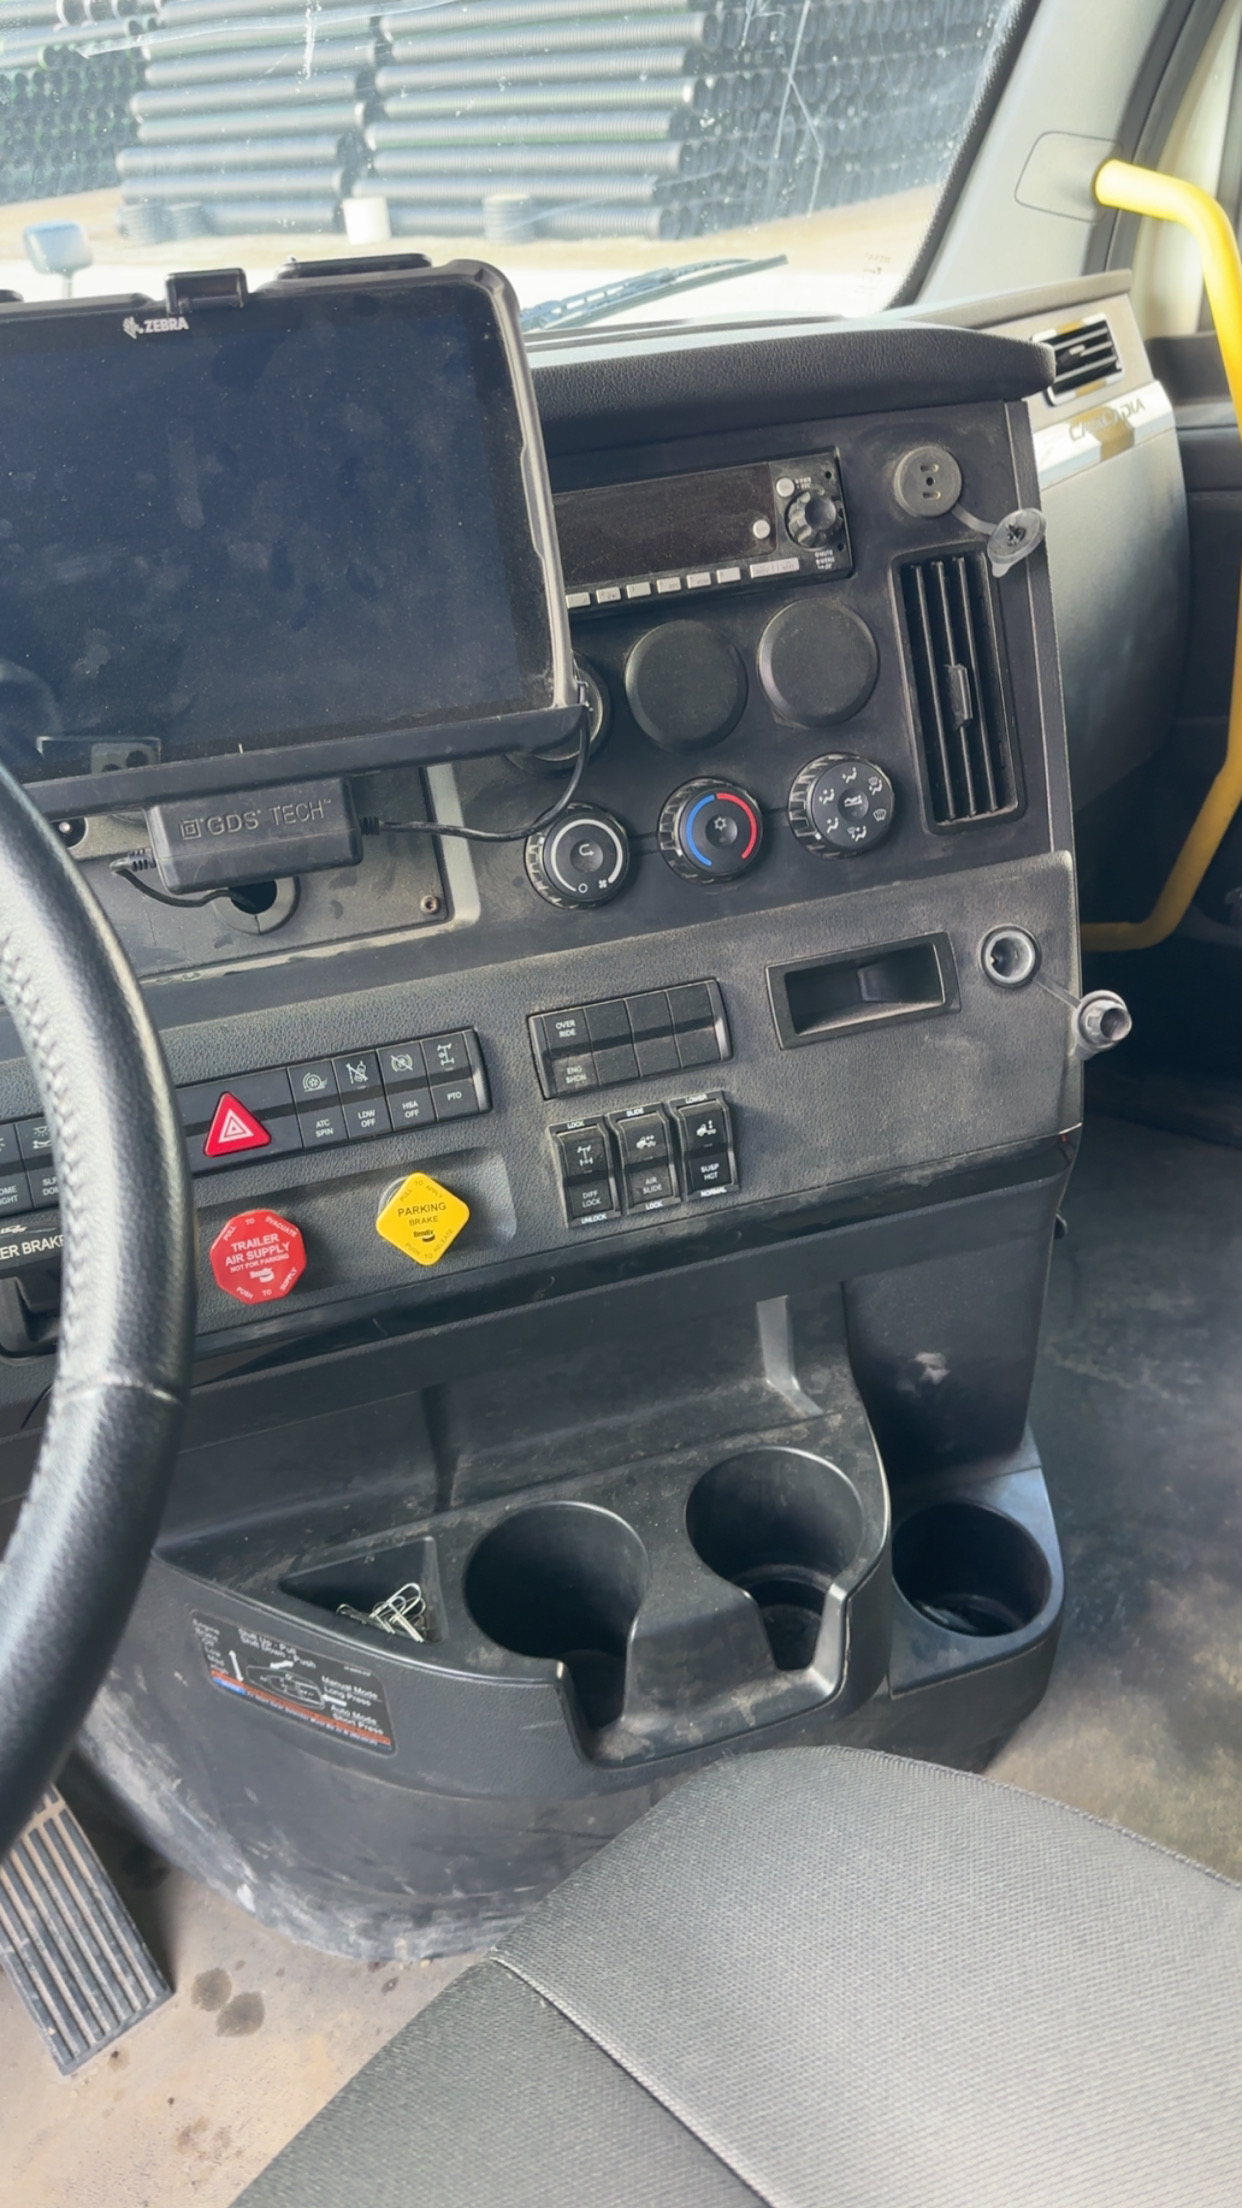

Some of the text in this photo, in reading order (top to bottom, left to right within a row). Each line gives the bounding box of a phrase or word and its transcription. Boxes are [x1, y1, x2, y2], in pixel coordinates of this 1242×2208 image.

[143, 316, 189, 334] ZEBRA
[206, 811, 260, 836] GDS
[555, 1019, 576, 1030] OVER
[559, 1028, 576, 1038] RIDE
[566, 1065, 582, 1075] ENG
[447, 1091, 462, 1101] PTO
[402, 1101, 419, 1111] HSA
[358, 1109, 376, 1120] LDW
[404, 1110, 420, 1119] OFF
[315, 1119, 331, 1129] ATC
[360, 1119, 376, 1128] OFF
[567, 1120, 585, 1129] LOCK
[315, 1128, 334, 1138] SPIN
[700, 1163, 720, 1174] SUSP
[645, 1176, 658, 1186] AIR
[642, 1184, 662, 1194] SLIDE
[582, 1190, 598, 1199] DIFF
[582, 1199, 601, 1208] LOCK
[645, 1201, 664, 1210] LOCK
[397, 1202, 447, 1217] PARKING
[408, 1215, 439, 1227] BRAKE
[581, 1214, 607, 1224] UNLOCK
[222, 1215, 298, 1241] PULL TO EVACUATE
[231, 1232, 279, 1252] TRAILER
[225, 1241, 290, 1266] AIR SUPPLY
[230, 1253, 290, 1273] NOT FOR PARKING
[236, 1286, 254, 1300] PUSH
[262, 1288, 272, 1296] TO
